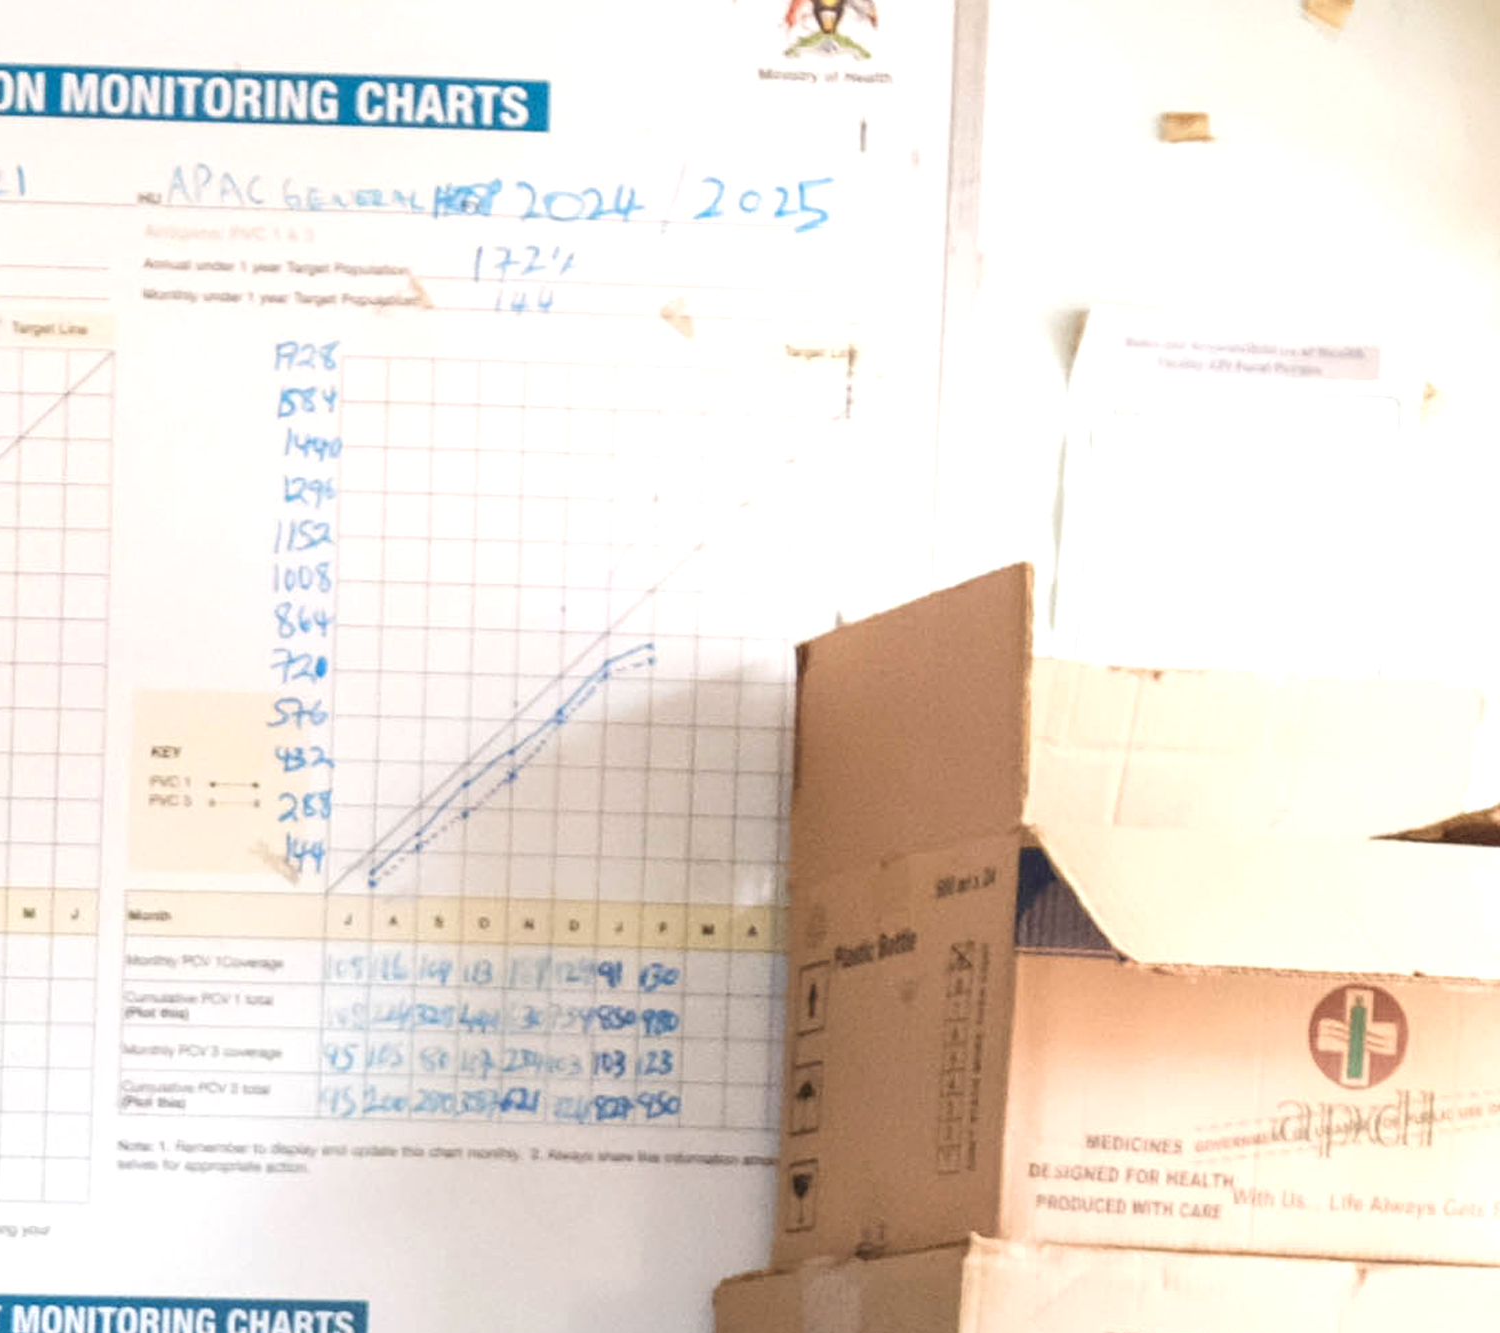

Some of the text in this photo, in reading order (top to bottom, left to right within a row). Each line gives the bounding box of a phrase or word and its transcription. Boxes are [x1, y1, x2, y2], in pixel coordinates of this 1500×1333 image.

[62, 73, 339, 122] MONITORING
[357, 82, 530, 126] CHARTS
[519, 178, 833, 232] 2024 2025
[274, 562, 331, 593] 1008
[1086, 1135, 1182, 1154] MEDICINES
[1029, 1162, 1234, 1189] DESIGNED FOR HEALTH
[1036, 1194, 1222, 1219] PRODUCED WITH CARE
